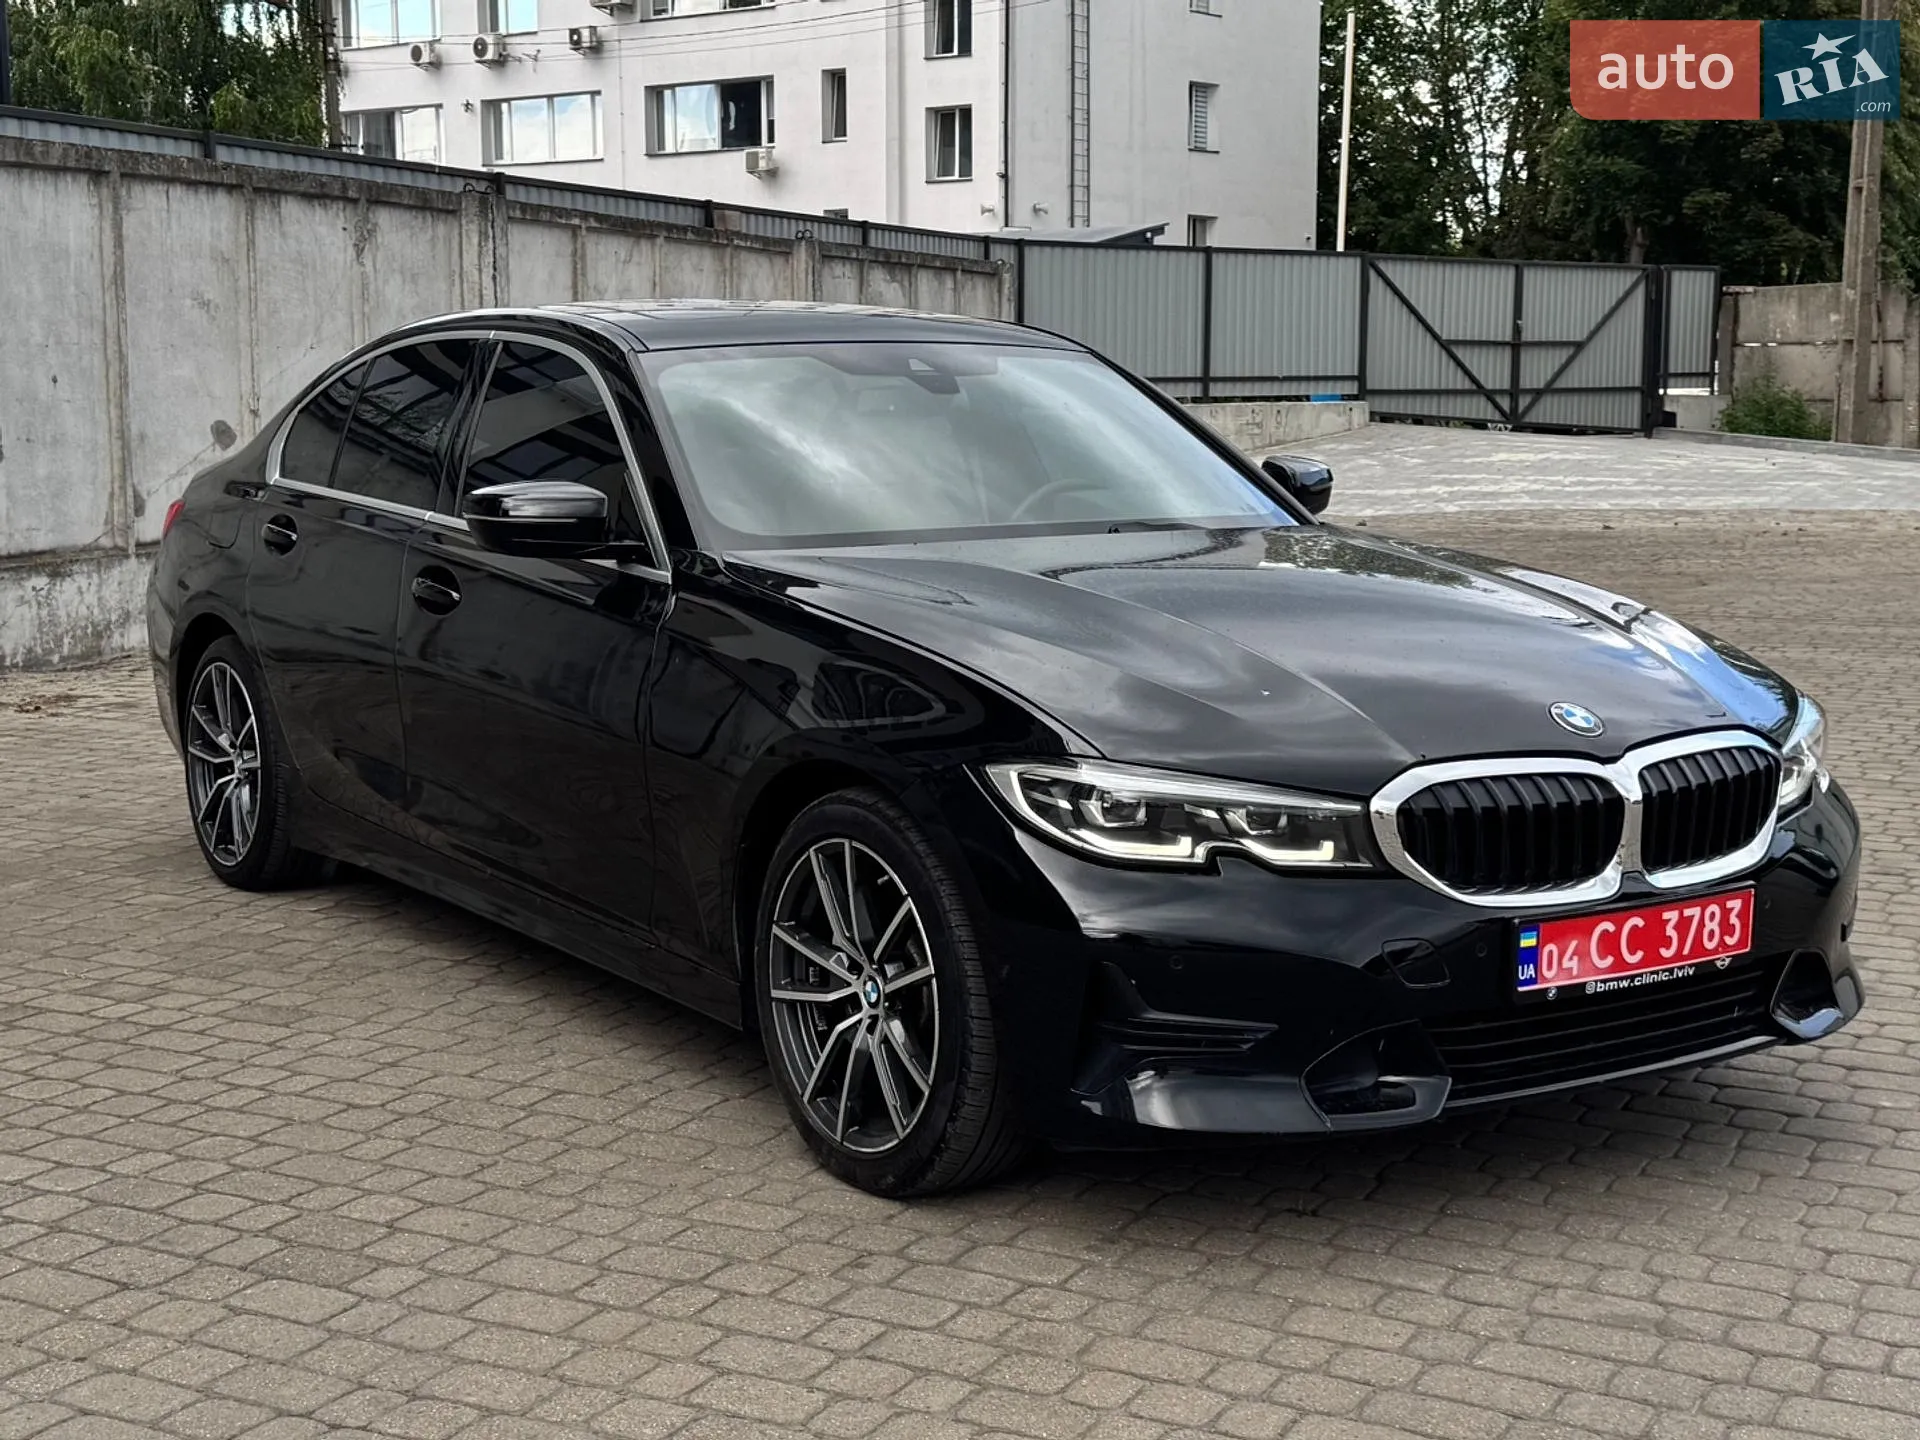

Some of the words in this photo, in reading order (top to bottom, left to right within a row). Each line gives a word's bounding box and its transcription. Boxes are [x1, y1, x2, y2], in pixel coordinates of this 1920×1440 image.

[1541, 940, 1579, 979] 04
[1589, 916, 1646, 969] CC
[1658, 898, 1743, 959] 3783
[1518, 965, 1536, 980] UA
